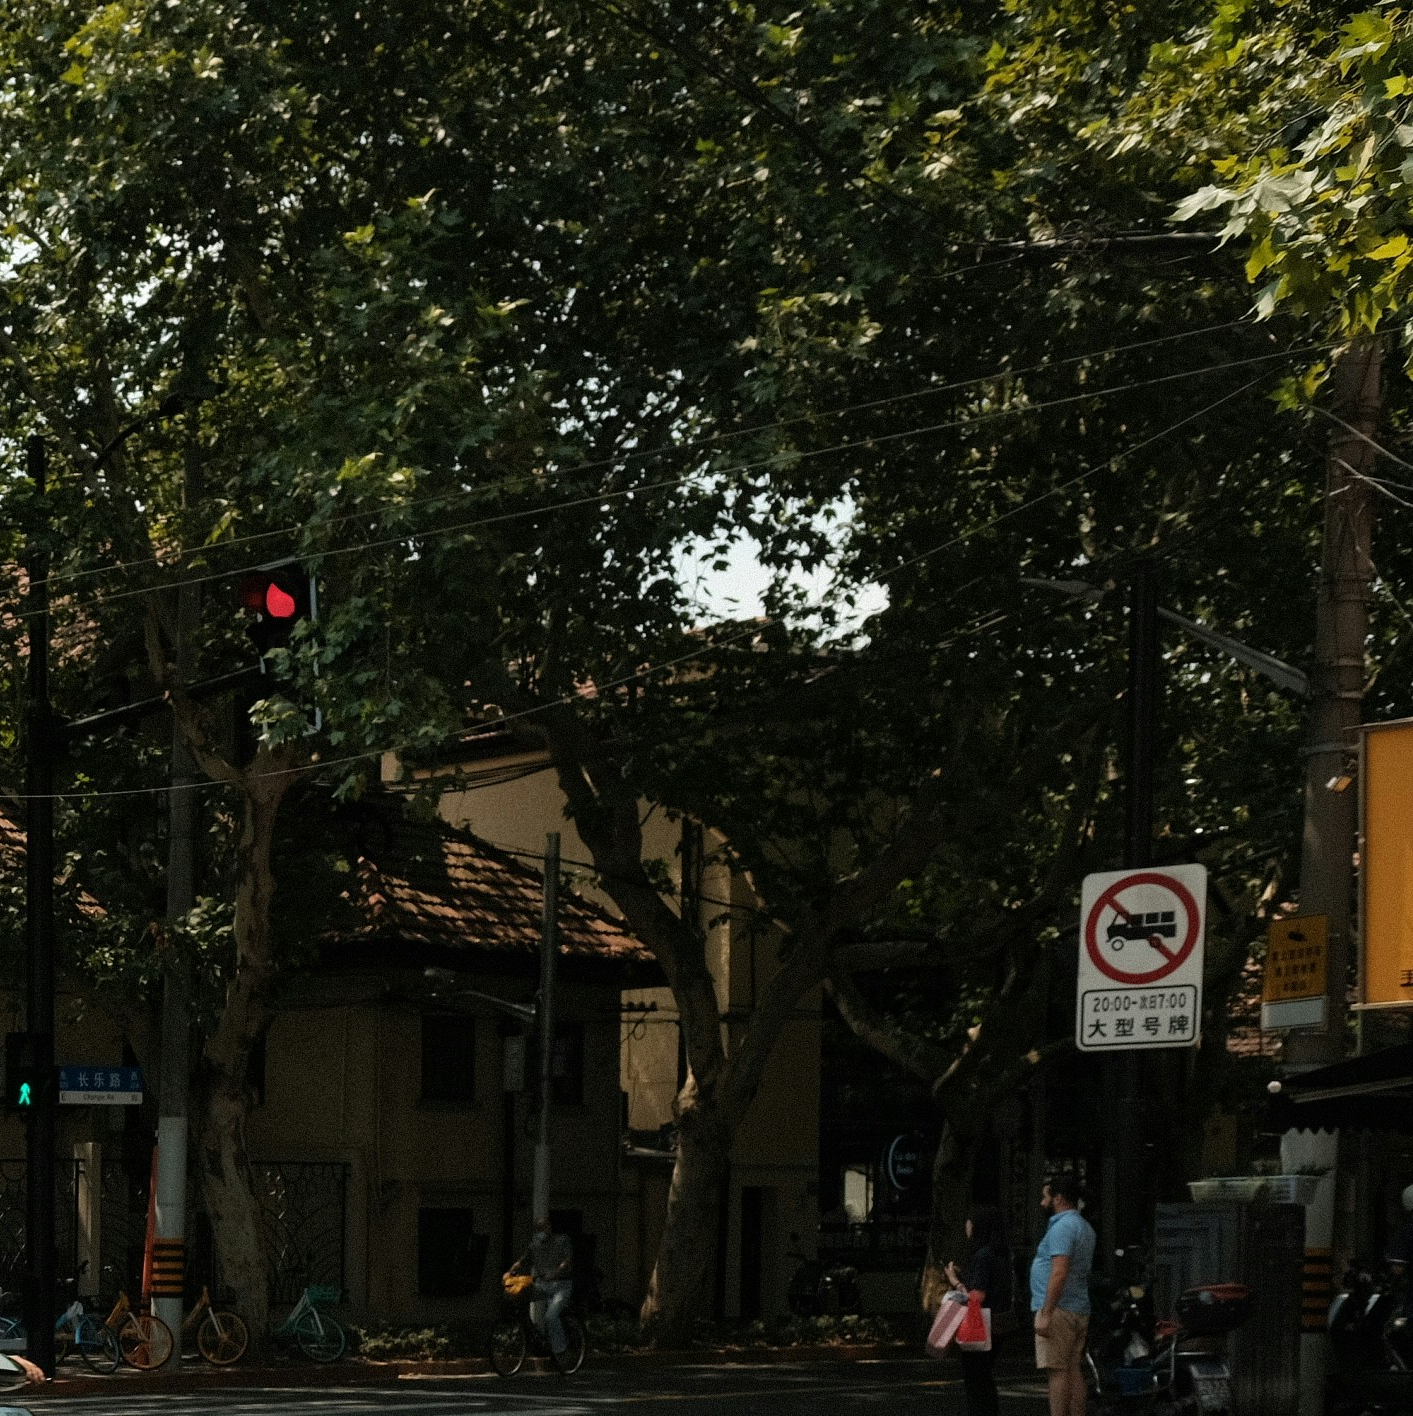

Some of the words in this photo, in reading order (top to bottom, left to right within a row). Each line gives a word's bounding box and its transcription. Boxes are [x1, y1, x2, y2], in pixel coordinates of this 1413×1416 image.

[1088, 1015, 1190, 1039] 大型号牌
[78, 1071, 121, 1088] 长乐路
